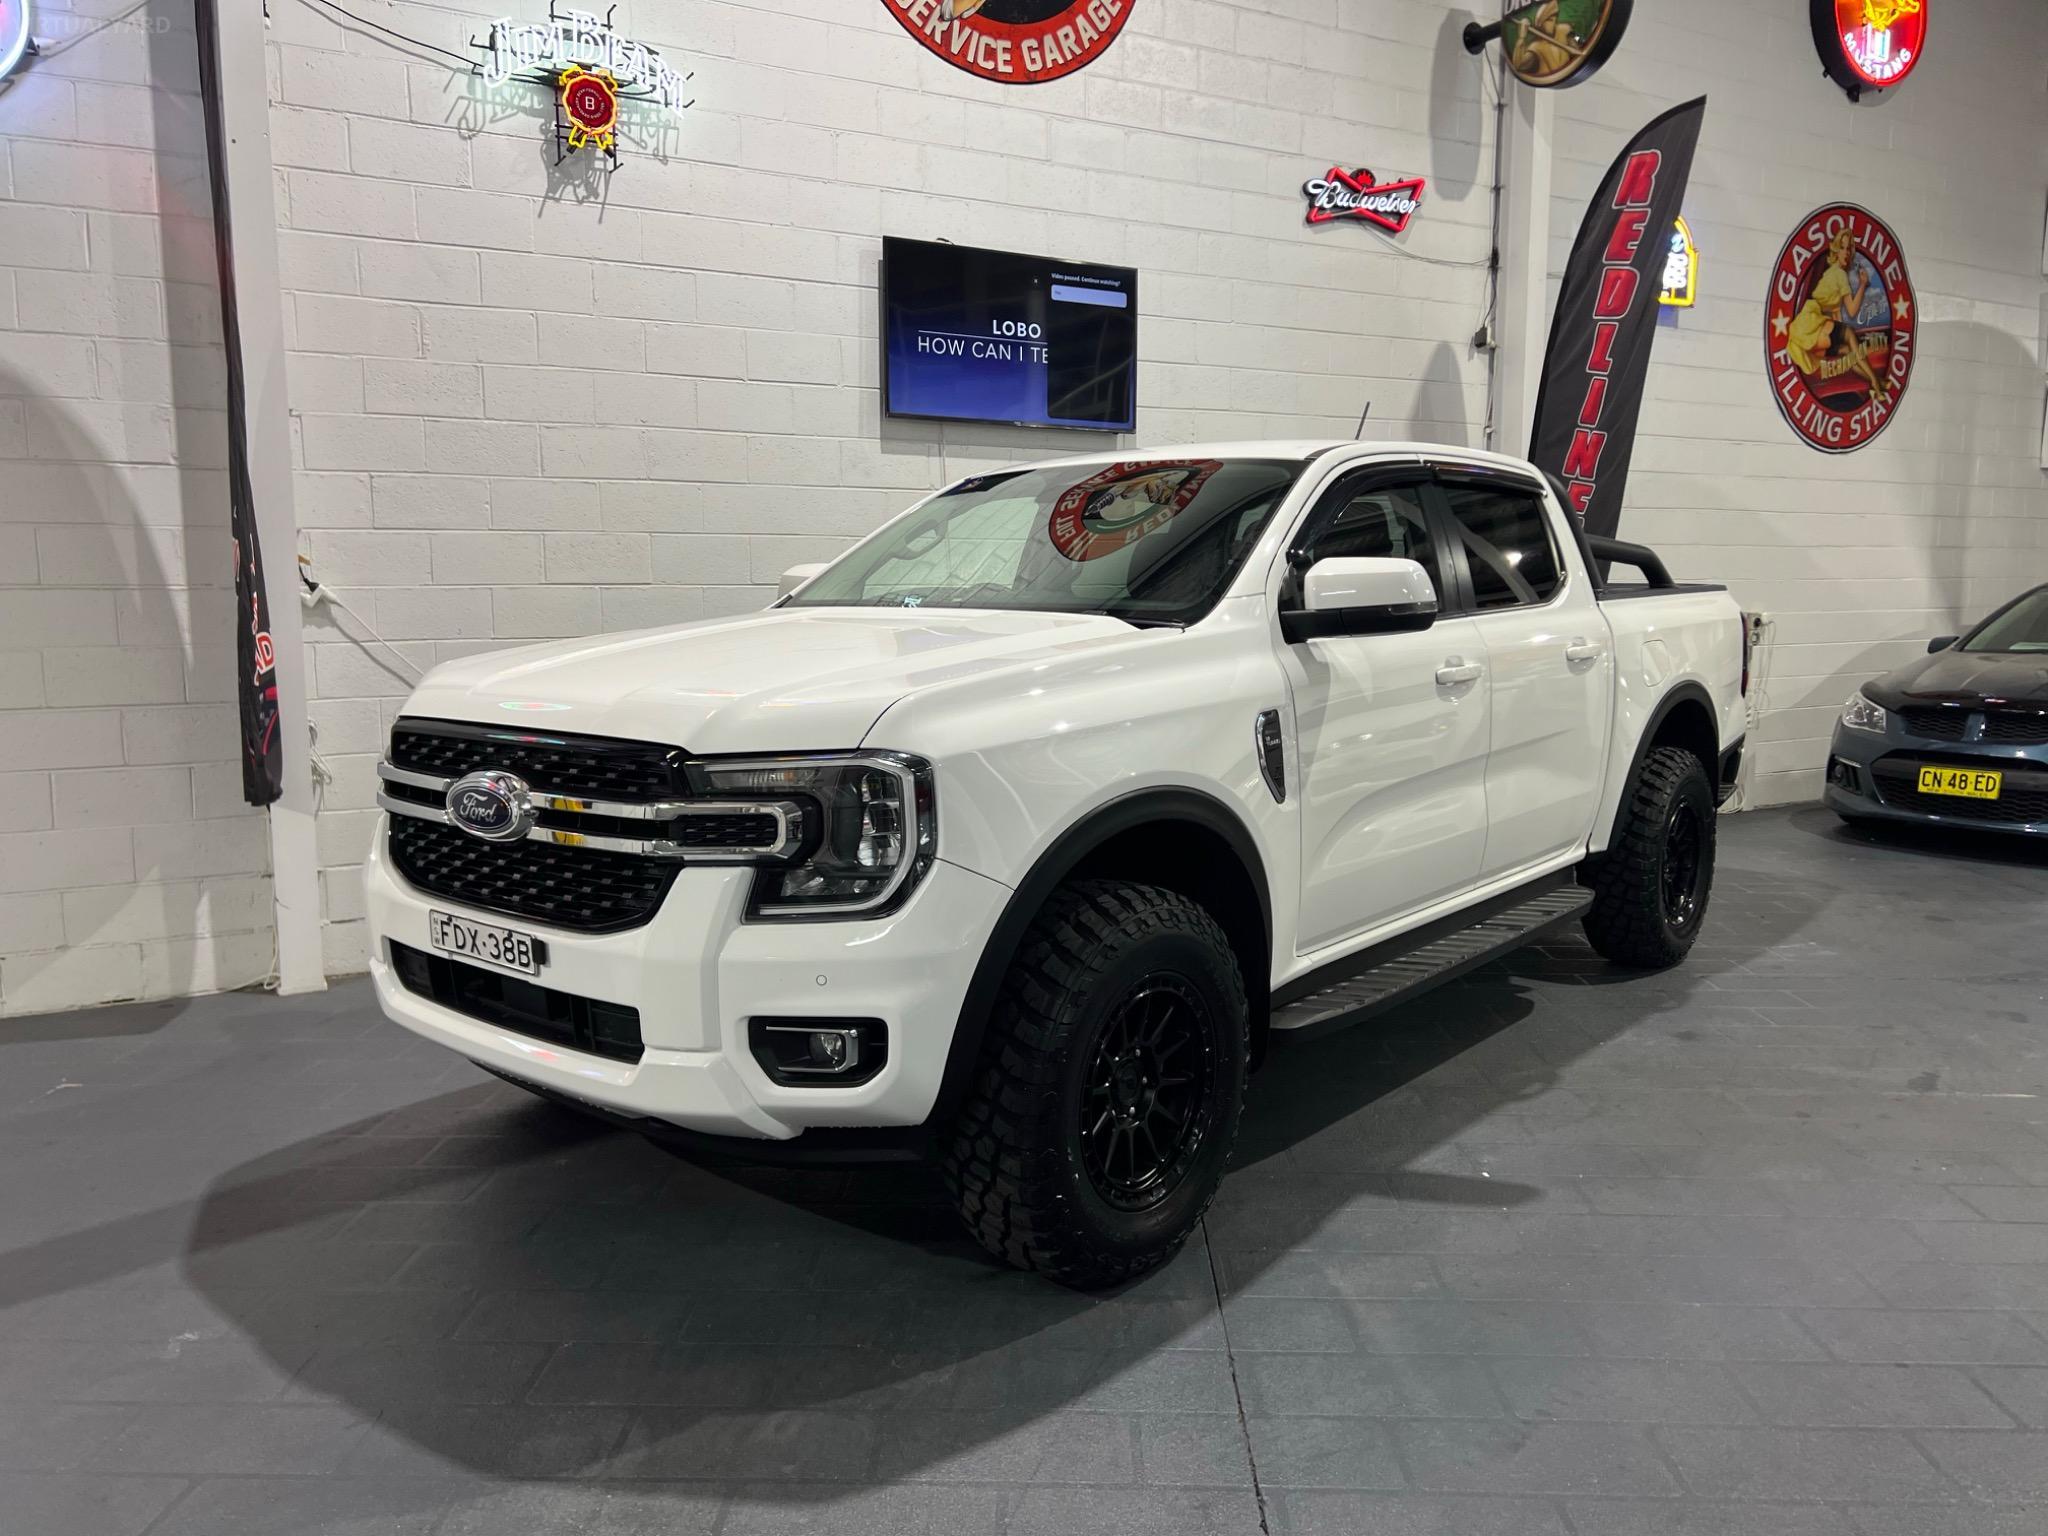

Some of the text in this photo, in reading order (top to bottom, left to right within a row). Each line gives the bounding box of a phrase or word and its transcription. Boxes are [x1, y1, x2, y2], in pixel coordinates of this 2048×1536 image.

[894, 0, 1014, 73] ERVICE
[1844, 32, 1912, 79] MUSTANG
[1307, 179, 1421, 214] Budweiser
[1778, 214, 1902, 302] GASOLINE
[918, 336, 965, 356] HOW
[972, 341, 1011, 361] CAN
[1019, 345, 1023, 362] I
[993, 320, 1041, 339] LOBO
[1773, 348, 1843, 442] FILLING
[459, 791, 498, 823] Ford
